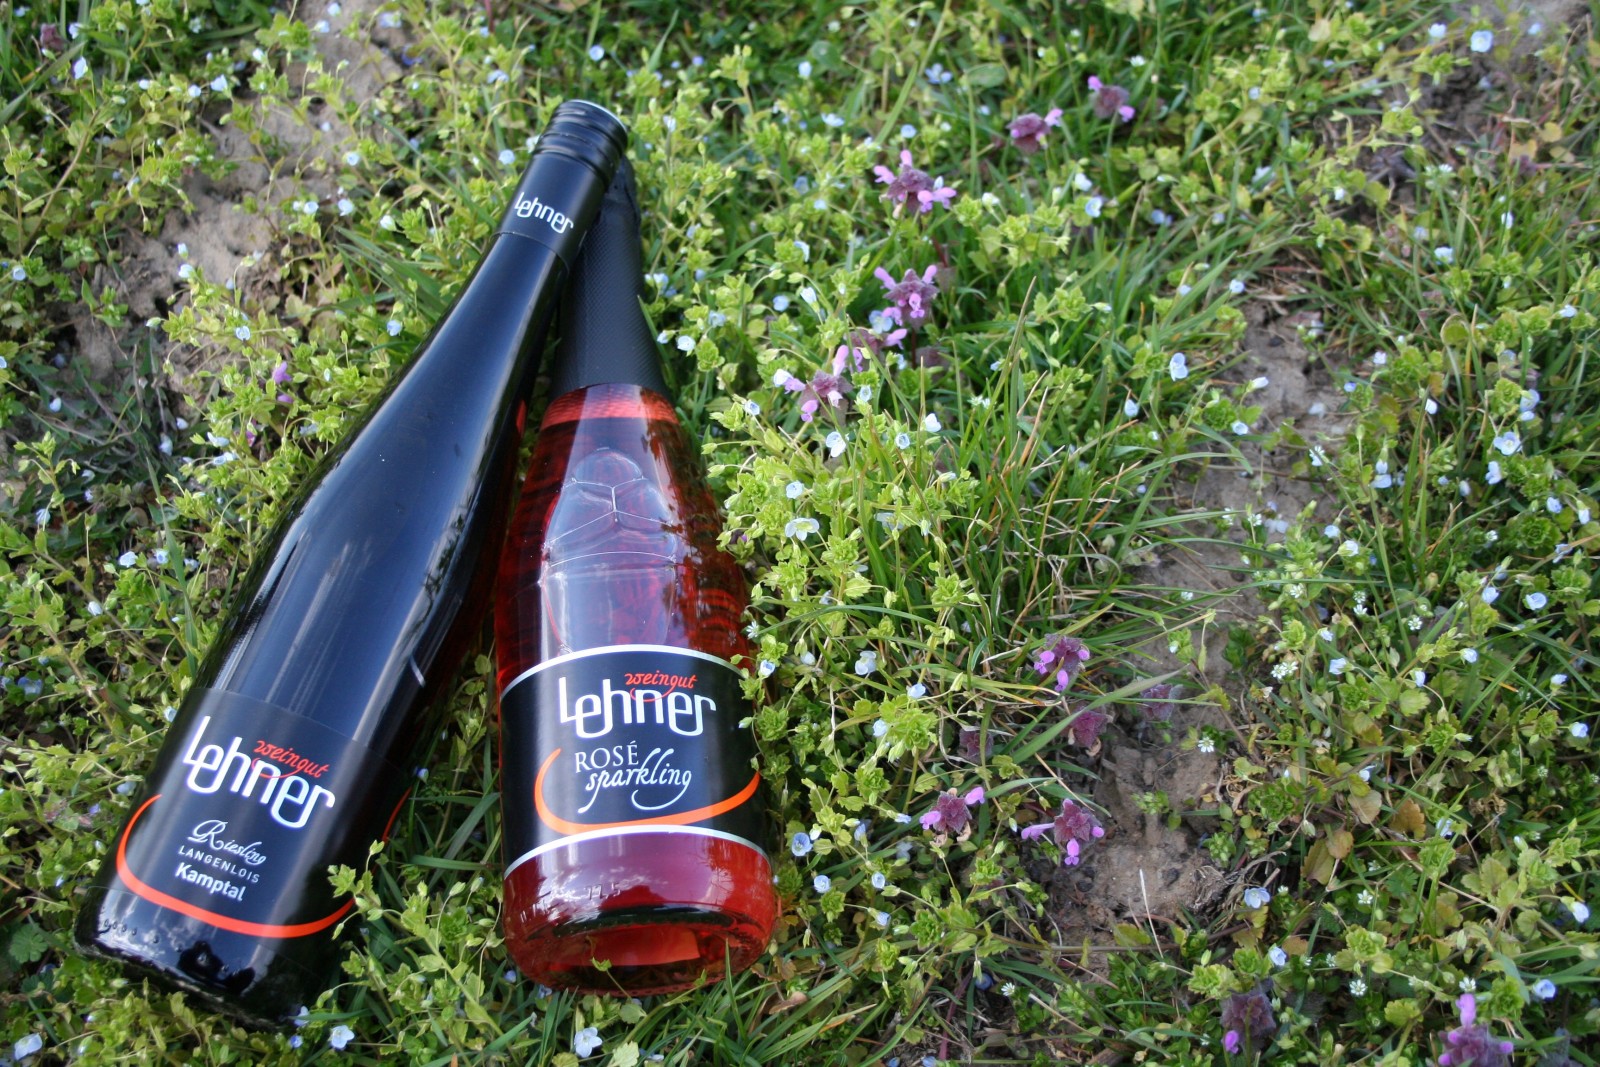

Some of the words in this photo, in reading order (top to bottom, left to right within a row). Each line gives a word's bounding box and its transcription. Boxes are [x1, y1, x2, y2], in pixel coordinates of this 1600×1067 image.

[514, 192, 574, 234] Lehner
[624, 670, 697, 702] weingut
[559, 677, 717, 738] Lehner
[183, 716, 336, 828] Lehner
[251, 740, 330, 778] weingut
[574, 740, 639, 773] ROSÉ
[578, 748, 691, 814] sparkling
[187, 820, 267, 865] Riesling
[175, 862, 246, 901] Kamptal
[178, 845, 260, 883] LANGENLOIS
